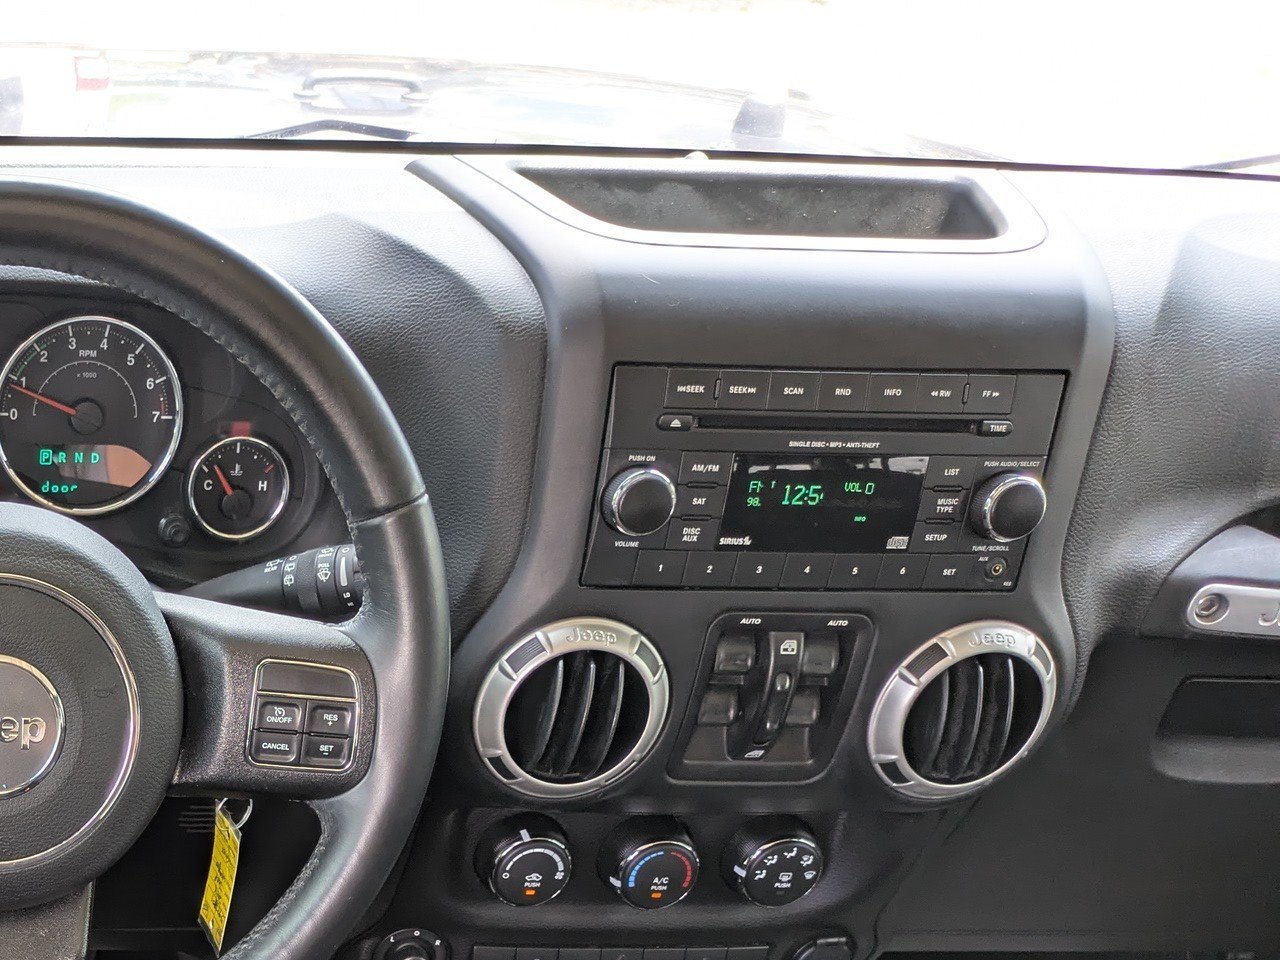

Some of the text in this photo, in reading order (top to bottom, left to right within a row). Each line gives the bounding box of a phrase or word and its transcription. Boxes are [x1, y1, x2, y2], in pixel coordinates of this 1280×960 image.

[68, 338, 76, 349] 3
[100, 338, 108, 349] 4
[40, 351, 48, 362] 2
[79, 350, 97, 358] RPM
[127, 354, 135, 366] 5
[21, 377, 27, 388] 1
[146, 377, 155, 389] 6
[686, 385, 705, 393] SEEK
[729, 386, 748, 394] SEEK
[783, 387, 804, 395] SCAN
[835, 388, 852, 396] RND
[884, 388, 902, 396] INFO
[982, 390, 992, 398] FF
[9, 409, 18, 420] 0
[152, 411, 160, 423] 7
[989, 425, 1007, 433] TIME
[788, 440, 811, 448] SINGLE
[58, 453, 67, 463] R
[74, 453, 84, 463] N
[91, 453, 100, 463] D
[691, 464, 720, 473] AM/FM
[944, 468, 960, 476] LIST
[42, 481, 78, 493] door
[204, 480, 213, 490] C
[258, 481, 268, 491] H
[844, 482, 862, 493] VOL
[782, 485, 824, 505] 12:5
[692, 498, 706, 506] SAT
[682, 527, 700, 535] DISC
[924, 534, 948, 542] SETUP
[706, 565, 713, 573] 2
[756, 566, 762, 574] 3
[803, 566, 811, 574] 4
[852, 567, 858, 575] 5
[900, 567, 906, 575] 6
[943, 568, 957, 576] SET
[566, 627, 617, 647] Jeep
[968, 631, 1016, 649] Jeep
[266, 716, 293, 724] ON/OFF
[323, 713, 338, 722] RES
[262, 743, 289, 751] CANCEL
